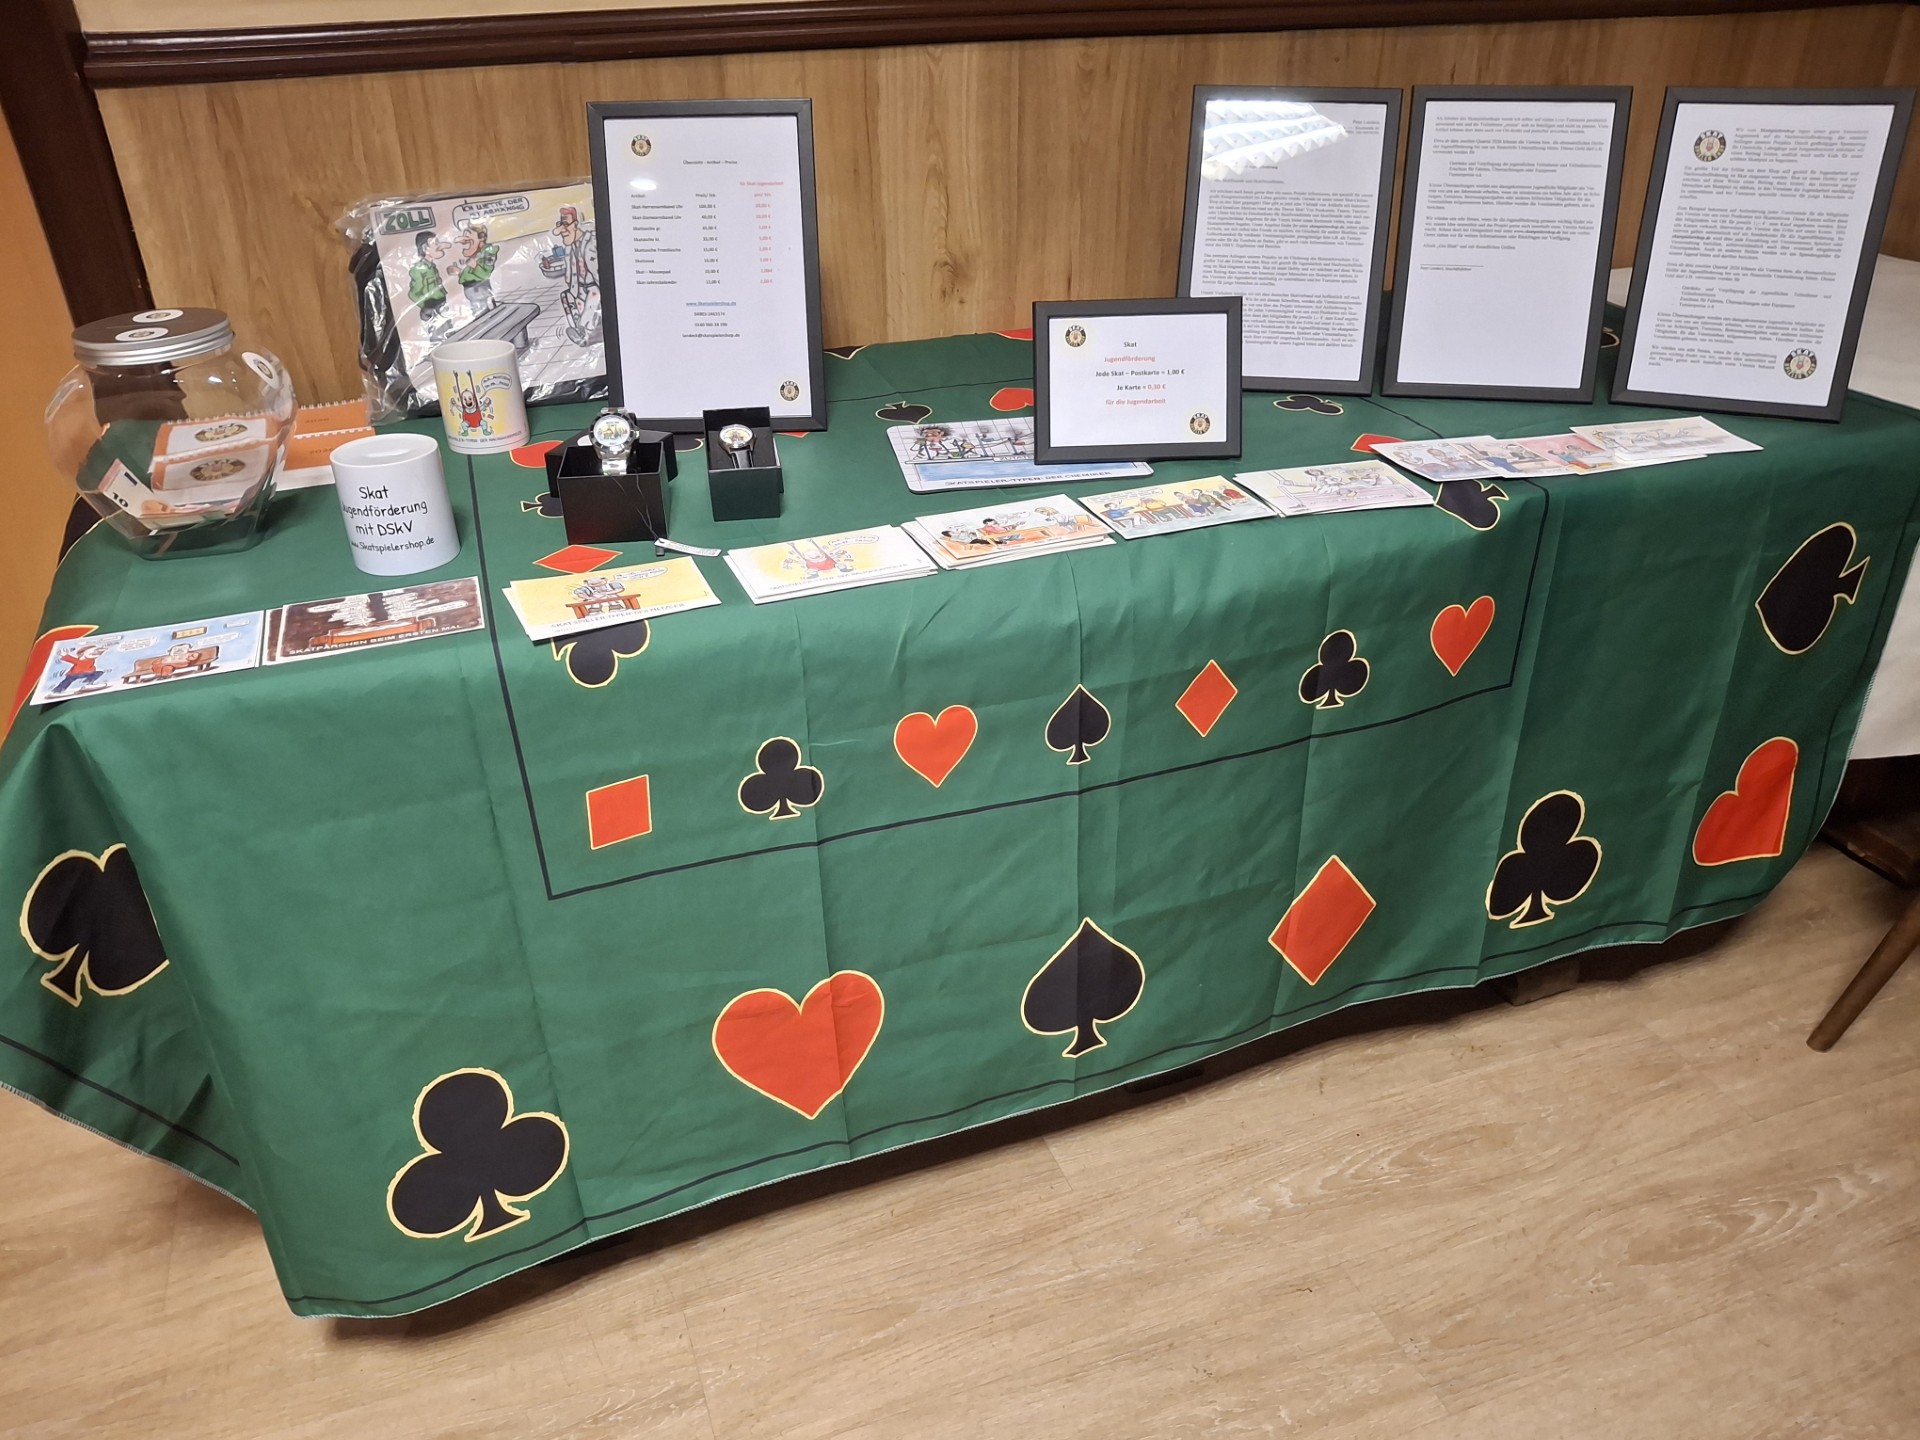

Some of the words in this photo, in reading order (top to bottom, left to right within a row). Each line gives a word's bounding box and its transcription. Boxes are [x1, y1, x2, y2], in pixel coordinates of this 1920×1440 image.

[383, 210, 431, 233] ZOLL
[1123, 340, 1137, 348] Skat
[1103, 355, 1156, 363] Jugendförderung
[1130, 369, 1160, 377] Postkarte
[112, 491, 129, 508] 10
[358, 484, 390, 500] Skat
[355, 522, 374, 536] mit
[377, 520, 414, 537] DSkV
